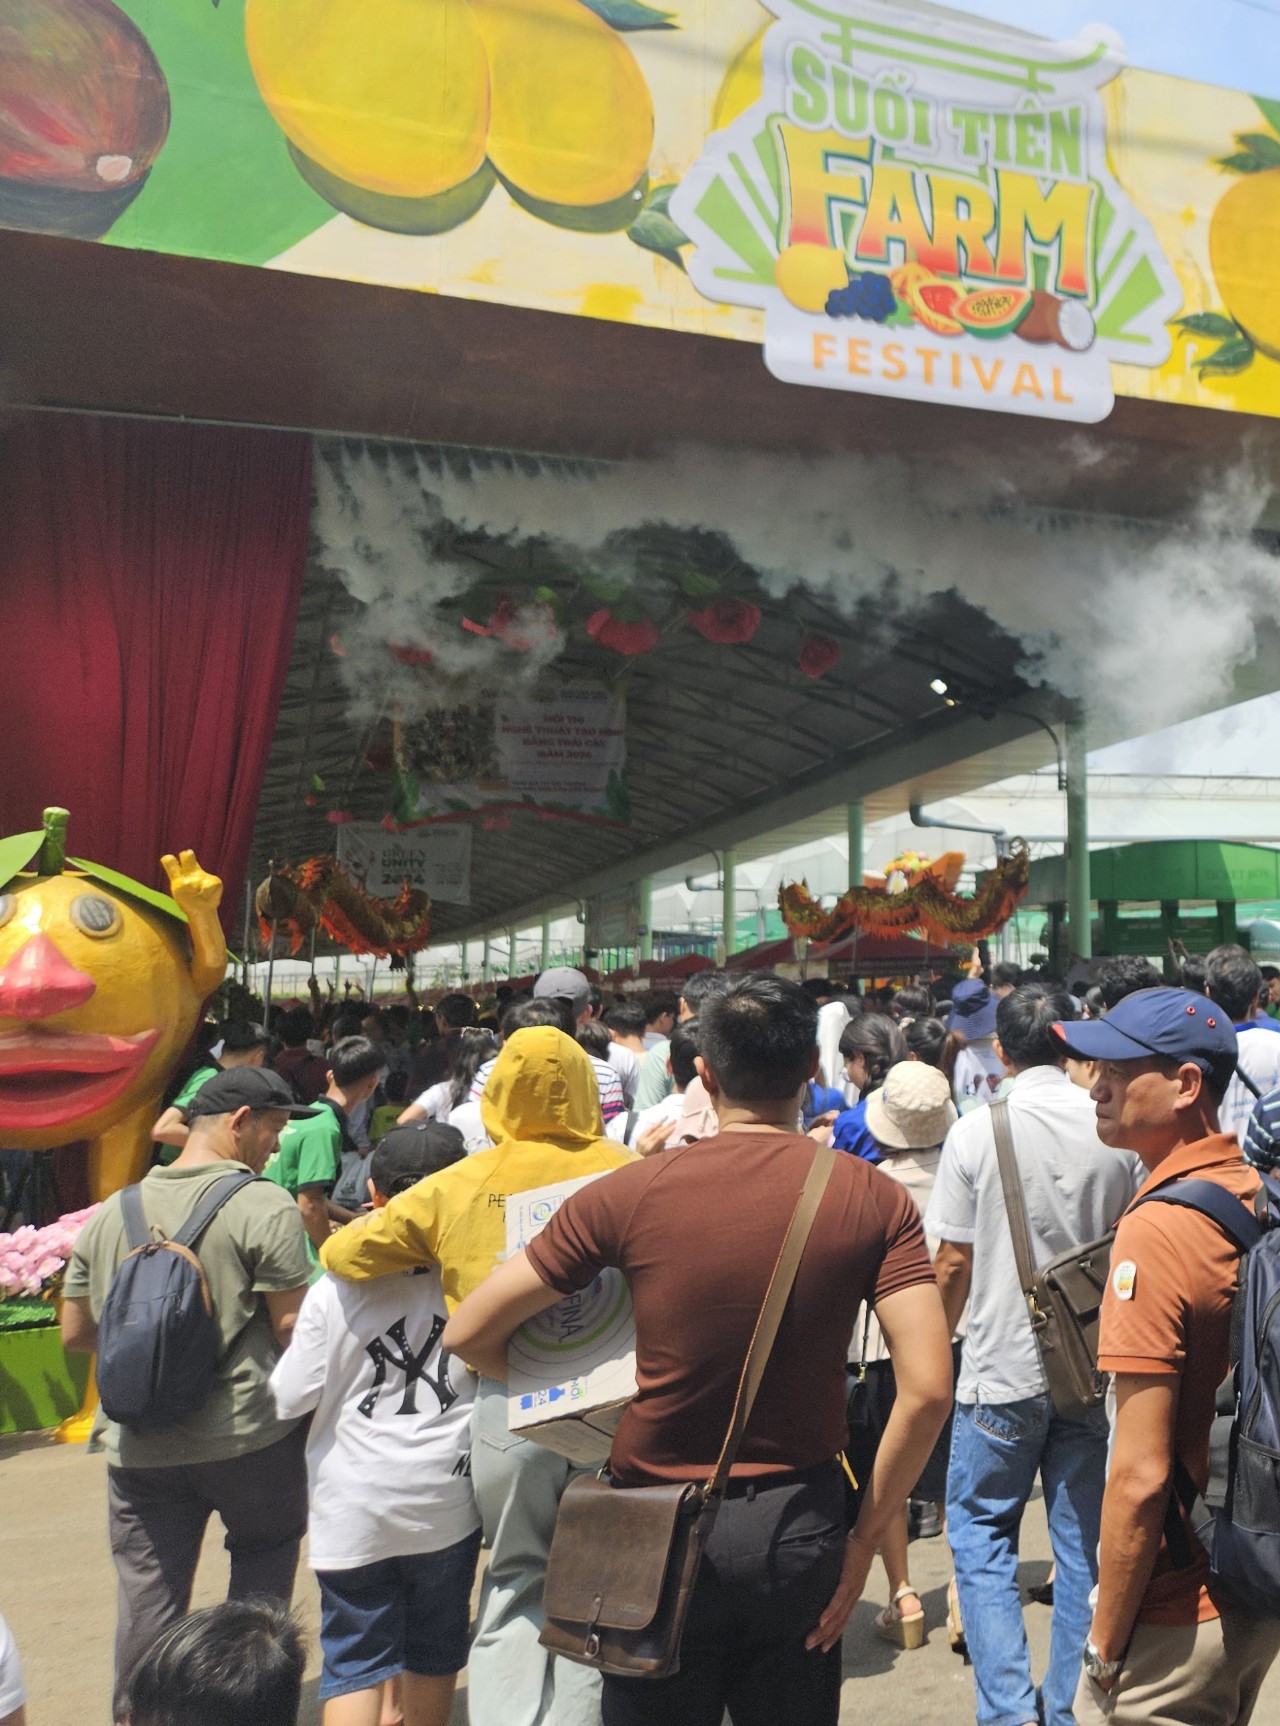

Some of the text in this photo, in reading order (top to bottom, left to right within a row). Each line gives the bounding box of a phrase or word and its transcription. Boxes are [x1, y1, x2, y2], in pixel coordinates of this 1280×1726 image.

[780, 122, 1095, 298] FARM
[812, 332, 1076, 405] FESTIVAL
[381, 858, 427, 867] UNITY
[559, 1292, 585, 1343] FINA
